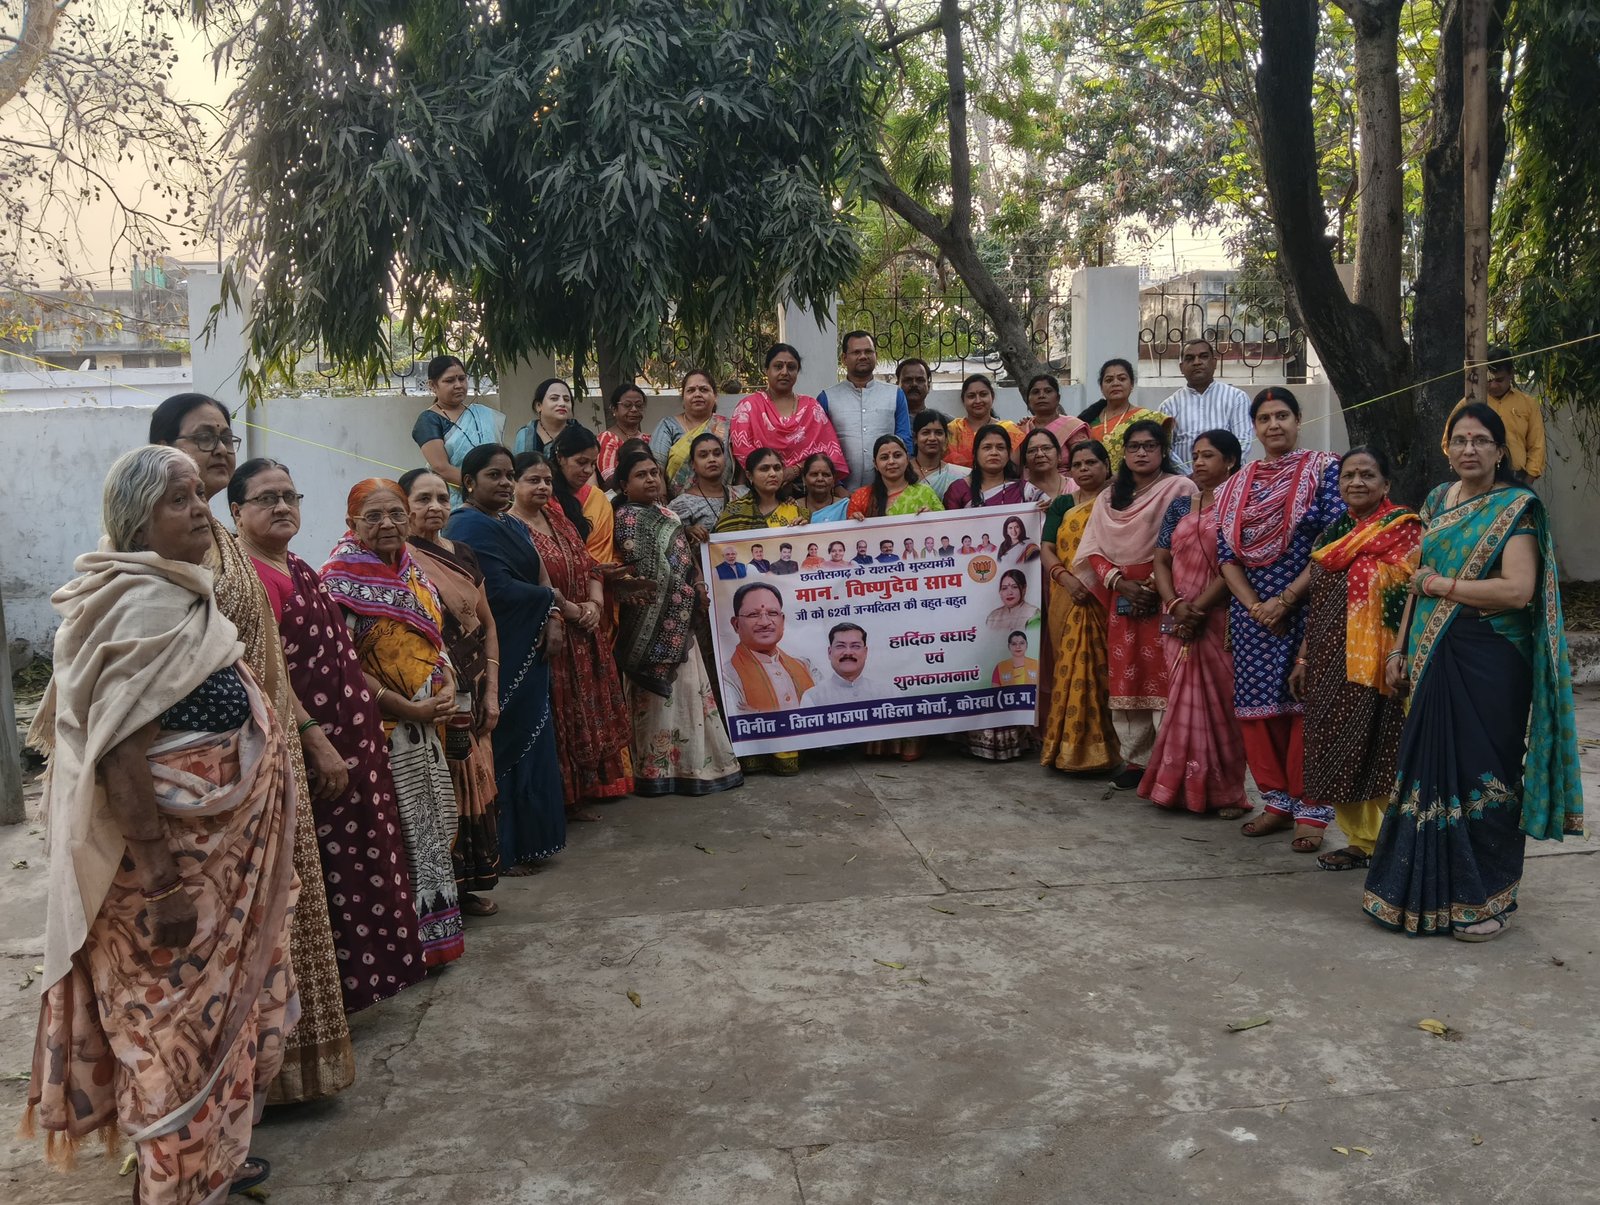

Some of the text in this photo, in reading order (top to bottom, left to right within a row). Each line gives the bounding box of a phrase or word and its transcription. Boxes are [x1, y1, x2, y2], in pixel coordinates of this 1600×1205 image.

[855, 564, 865, 577] के
[869, 560, 905, 575] यशस्वी
[909, 556, 955, 572] मुख्यमंत्री
[795, 573, 963, 603] मान. विष्णुदेव साय
[794, 608, 808, 621] जी
[811, 606, 824, 619] को
[854, 601, 900, 615] जन्मदिवस
[904, 598, 917, 610] की
[920, 595, 967, 611] बहुत-बहुत
[889, 631, 935, 649] हार्दिक
[925, 648, 945, 664] एवं
[736, 717, 776, 736] विनीत
[789, 713, 824, 730] जिला
[827, 708, 868, 725] भाजपा
[872, 701, 913, 719] महिला
[916, 696, 952, 716] मोर्चा,
[956, 695, 994, 710] कोरबा
[997, 689, 1037, 709] (छ.ग.
